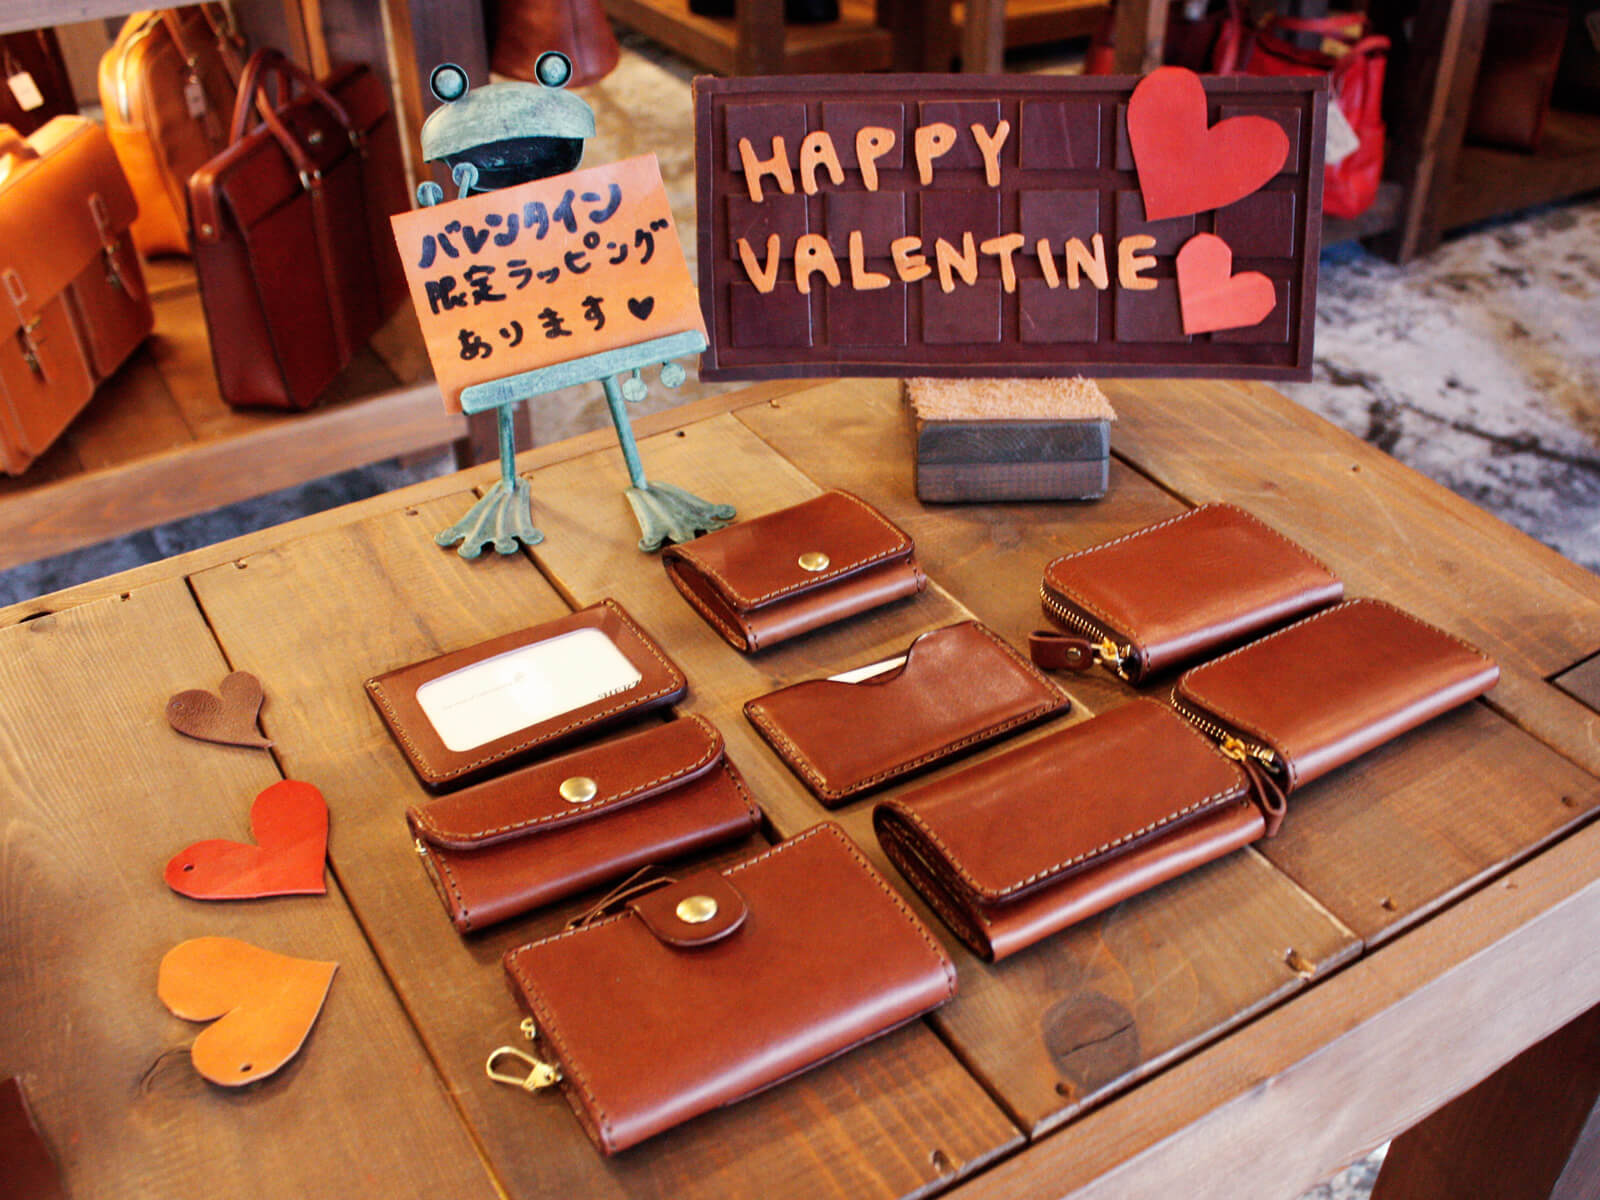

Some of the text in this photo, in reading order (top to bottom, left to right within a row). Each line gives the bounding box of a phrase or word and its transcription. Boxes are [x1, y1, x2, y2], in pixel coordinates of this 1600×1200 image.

[738, 120, 1010, 202] HAPPY
[418, 183, 622, 269] バレンタイン
[424, 218, 669, 315] 限定ラッピング
[737, 231, 1159, 294] VALENTINE
[457, 296, 606, 361] あります
